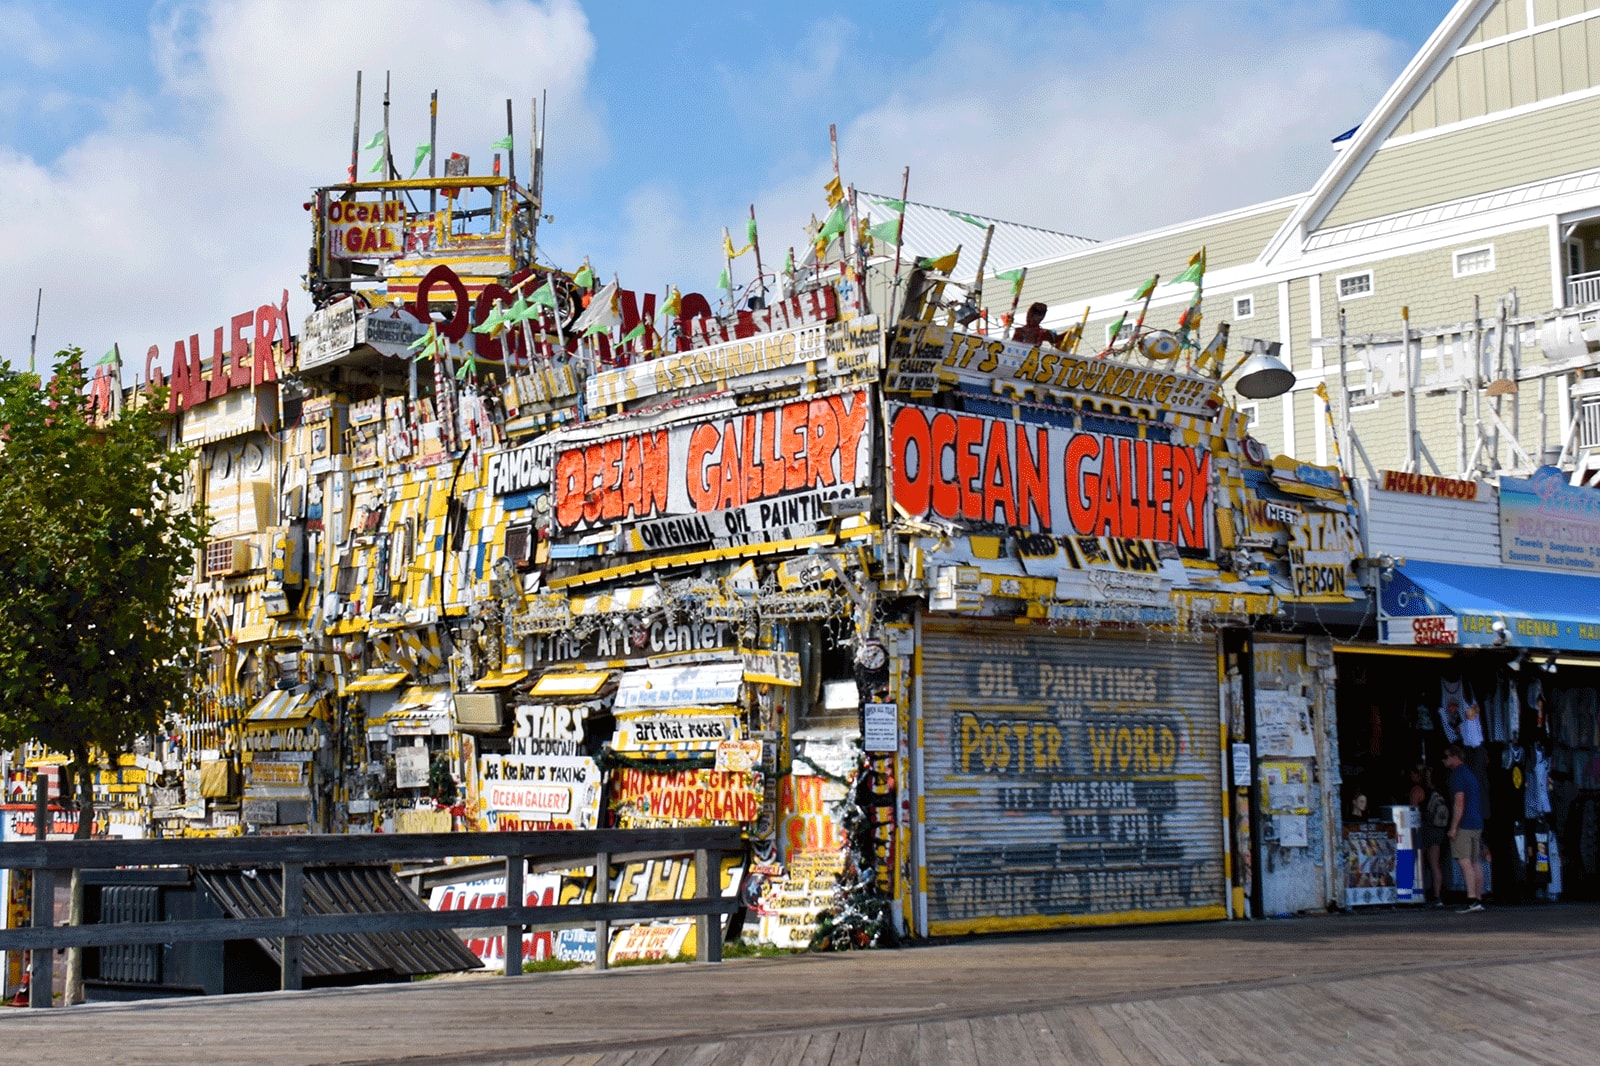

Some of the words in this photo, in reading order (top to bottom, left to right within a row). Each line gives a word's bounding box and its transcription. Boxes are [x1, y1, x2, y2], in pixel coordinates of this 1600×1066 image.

[690, 314, 739, 350] ART
[753, 286, 828, 335] SALE!
[145, 288, 295, 414] GALLERY
[827, 338, 846, 353] PAUL
[943, 333, 1005, 373] IT'S
[837, 351, 870, 370] GALLERY
[900, 360, 936, 374] GALLERY
[596, 368, 639, 405] IT'S
[556, 428, 670, 529] OCEAN
[686, 389, 869, 514] GALLERY
[891, 405, 1050, 528] OCEAN
[1065, 433, 1211, 550] GALLERY
[1384, 470, 1478, 500] HOLLYWOOD
[640, 514, 715, 548] ORIGINAL
[724, 507, 751, 535] OIL
[1293, 512, 1364, 559] STARS
[1514, 537, 1544, 549] Towels
[1297, 567, 1346, 595] PERSON
[597, 622, 634, 659] Art
[650, 617, 727, 653] Center
[1412, 617, 1446, 632] OCEAN
[1414, 629, 1457, 645] GALLERY
[1461, 616, 1494, 634] VAPE
[1516, 617, 1559, 638] HENNA
[976, 661, 1019, 698] OIL
[1039, 663, 1159, 701] PAINTINGS
[277, 727, 320, 752] WORLD
[635, 722, 657, 741] art
[660, 721, 685, 739] that
[688, 721, 724, 739] rocks
[960, 715, 1063, 775] POSTER
[1088, 725, 1176, 773] WORLD
[484, 760, 499, 781] JOE
[519, 762, 536, 781] ART
[538, 766, 546, 781] IS
[549, 766, 587, 784] TAKING
[610, 768, 700, 802] CHRISTMAS
[492, 788, 524, 808] OCEAN
[525, 790, 568, 810] GALLERY
[649, 787, 758, 821] WONDERLAND
[781, 774, 827, 815] ART
[1049, 781, 1137, 808] AWESOME
[486, 810, 498, 825] TO
[786, 814, 847, 862] SAL
[559, 942, 598, 962] faceboo
[627, 936, 636, 949] IS
[638, 936, 646, 948] A
[647, 936, 668, 948] LIVE
